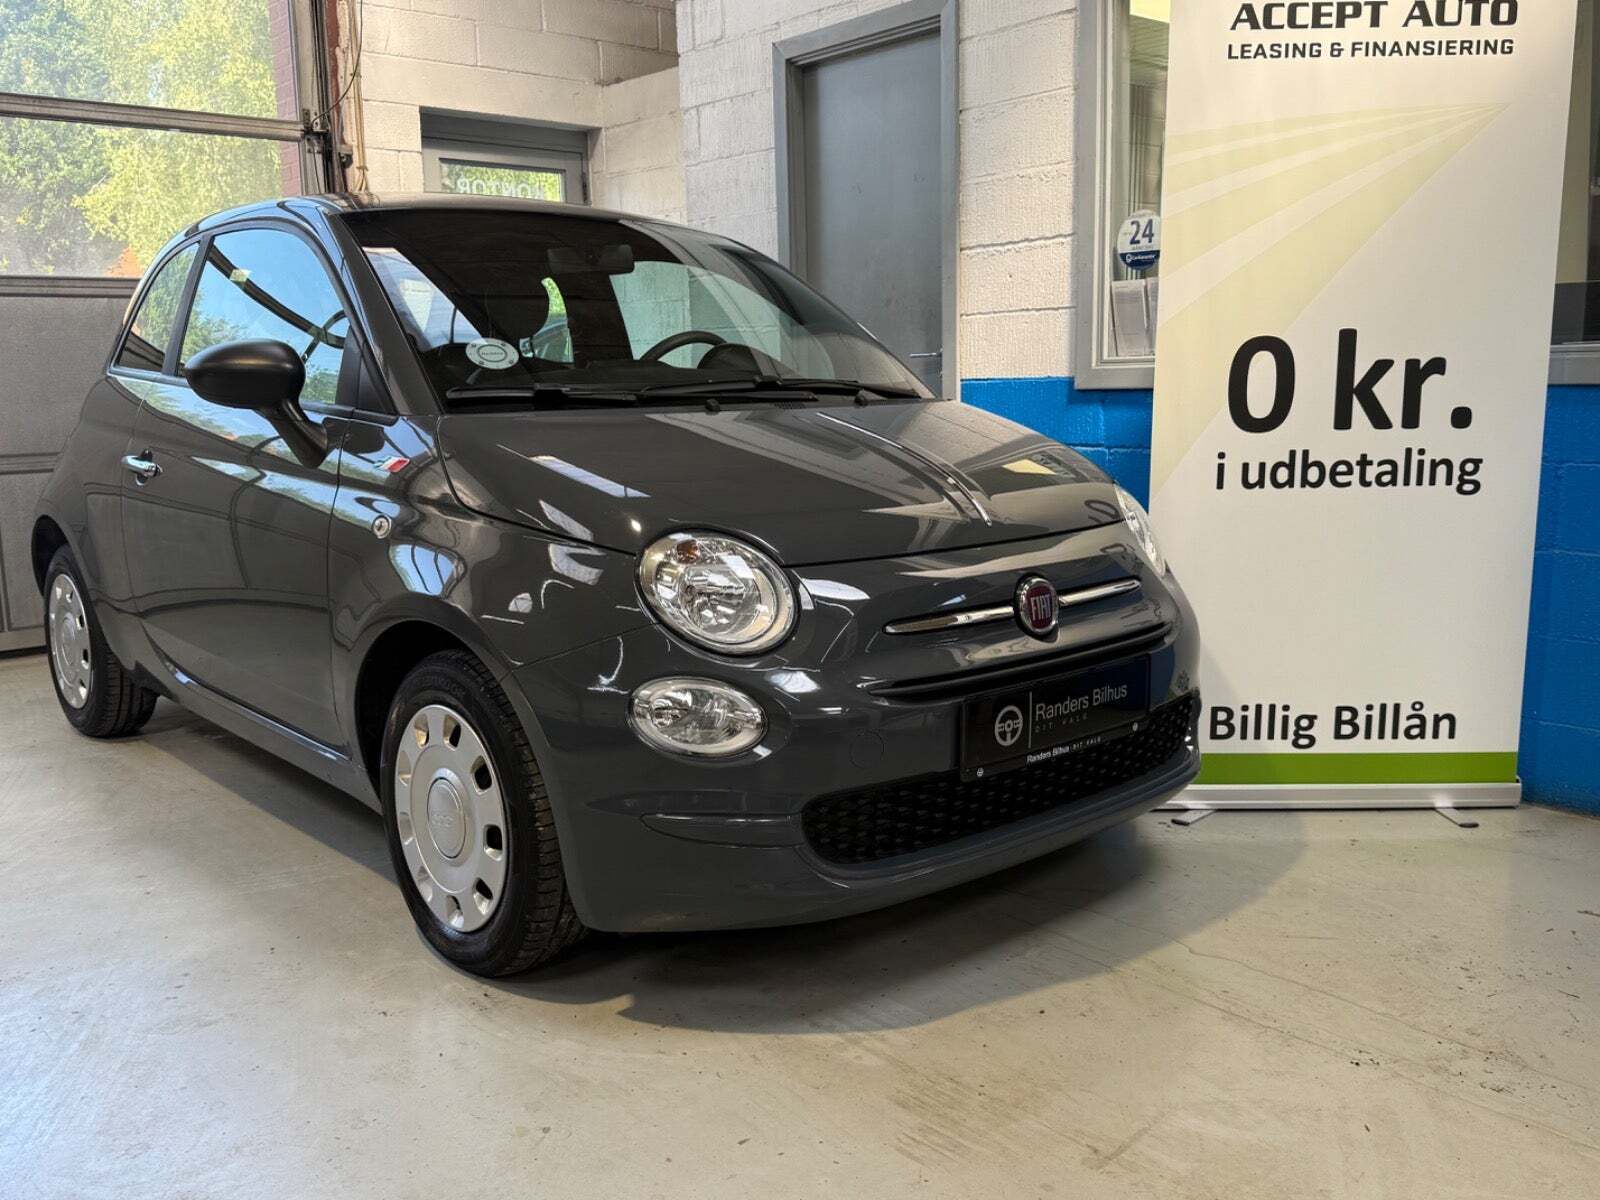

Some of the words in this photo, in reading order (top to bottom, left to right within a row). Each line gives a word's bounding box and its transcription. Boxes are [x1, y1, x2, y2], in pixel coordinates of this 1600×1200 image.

[1230, 0, 1388, 30] ACCEPT
[1402, 0, 1518, 28] AUTO
[1227, 42, 1322, 59] LEASING
[1330, 42, 1344, 58] &
[1351, 39, 1514, 57] FINANSIERING
[1129, 219, 1154, 245] 24
[1228, 335, 1295, 433] 0
[1333, 328, 1472, 430] kr.
[1216, 452, 1226, 490] i
[1241, 447, 1483, 496] udbetaling
[1030, 594, 1051, 620] FIAT
[1035, 695, 1089, 721] Randers
[1093, 684, 1127, 705] Bilhus
[1209, 703, 1318, 749] Billig
[1333, 701, 1457, 740] Billån
[1026, 750, 1051, 763] Randers
